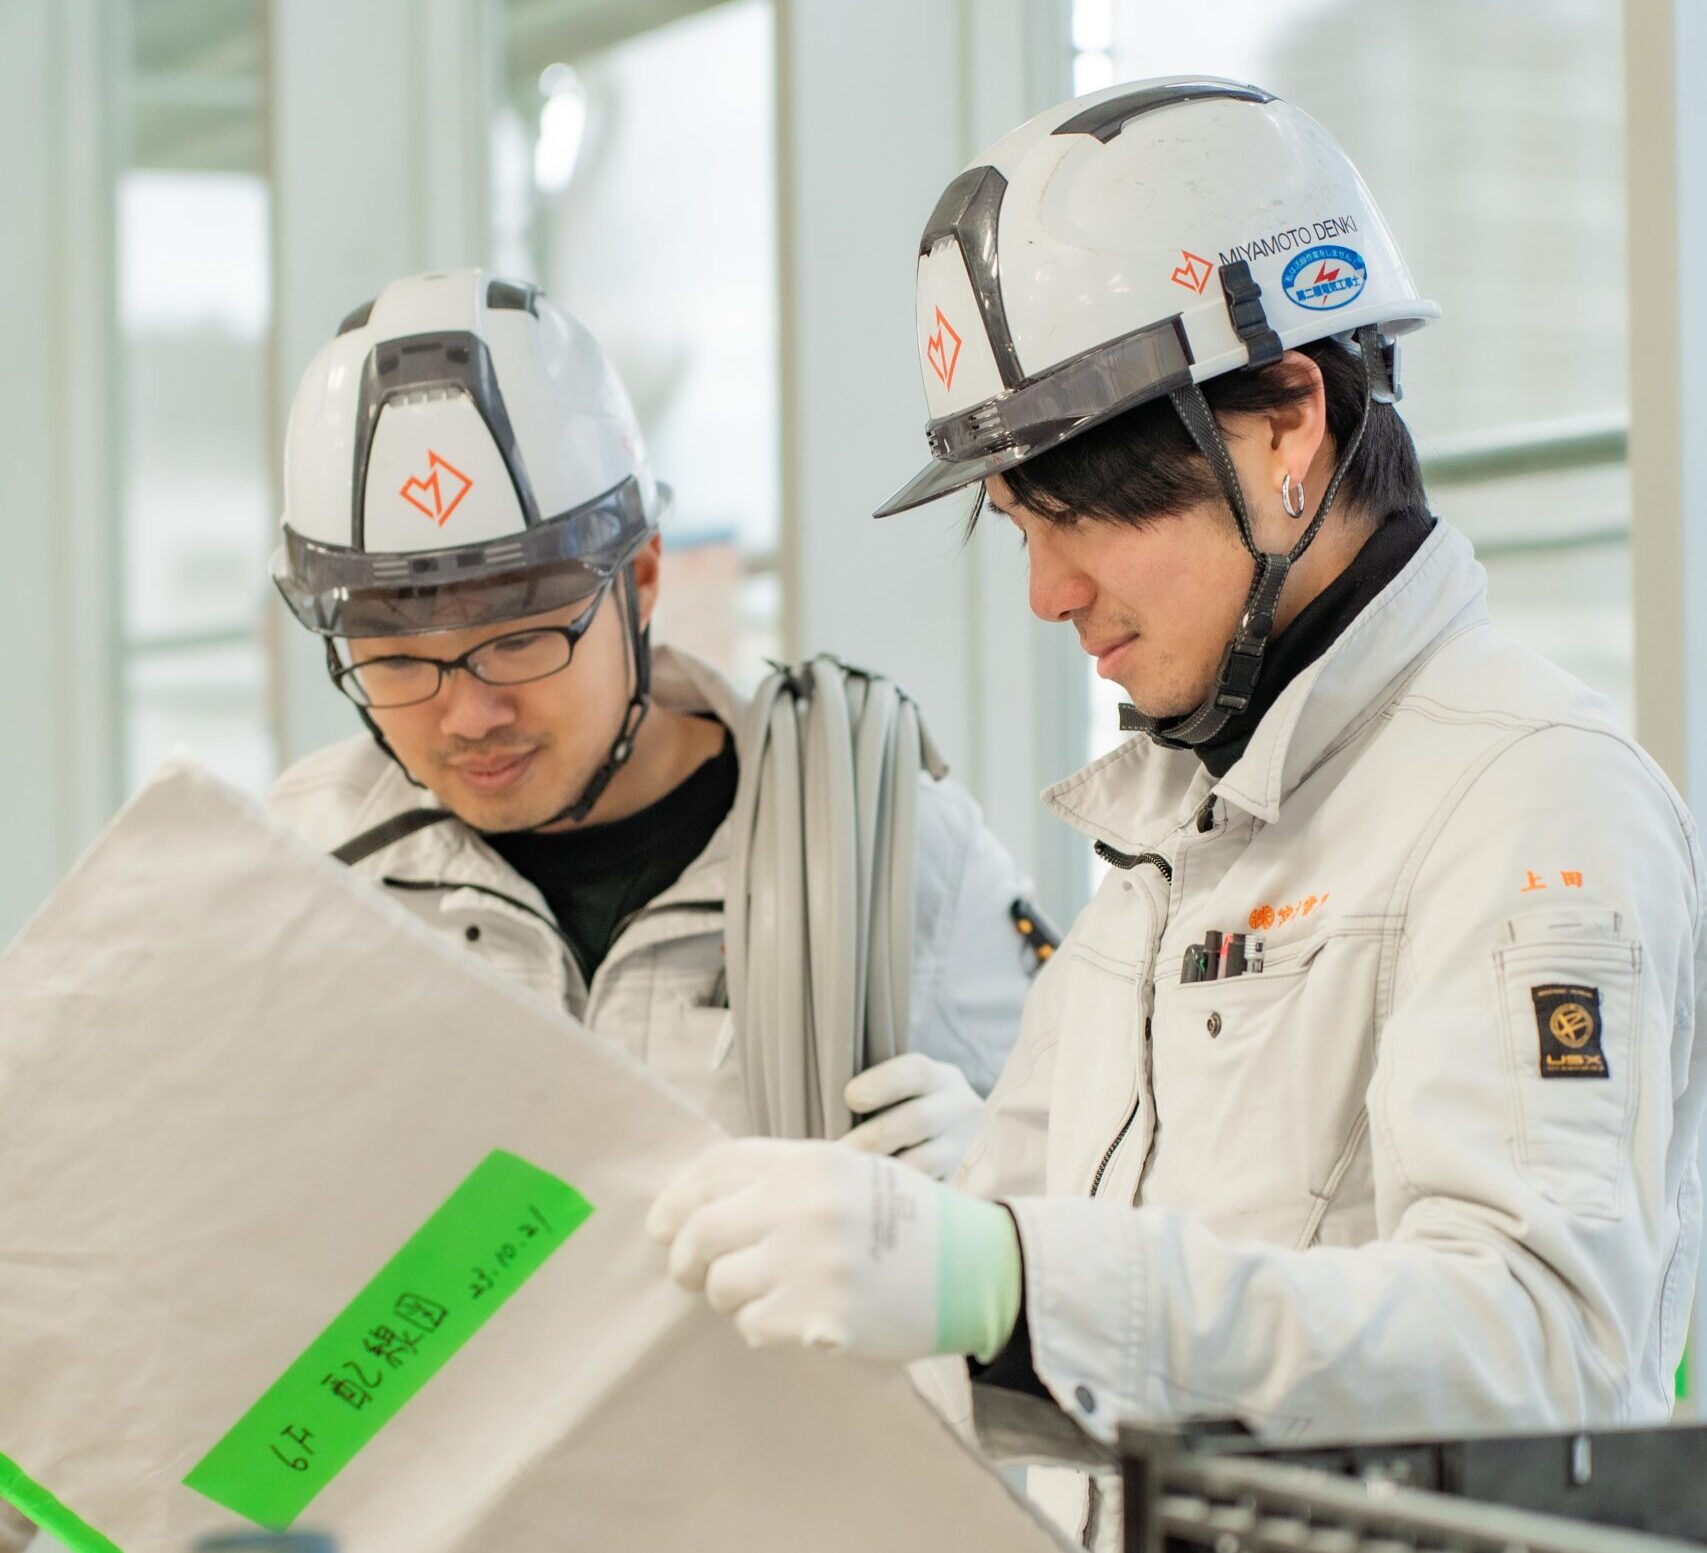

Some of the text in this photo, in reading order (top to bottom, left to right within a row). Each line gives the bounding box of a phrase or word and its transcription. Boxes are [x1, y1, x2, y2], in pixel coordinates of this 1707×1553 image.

[1218, 215, 1358, 265] MIYAMOTO DENKI
[269, 1425, 316, 1472] 6F
[320, 1292, 449, 1411] 配線図
